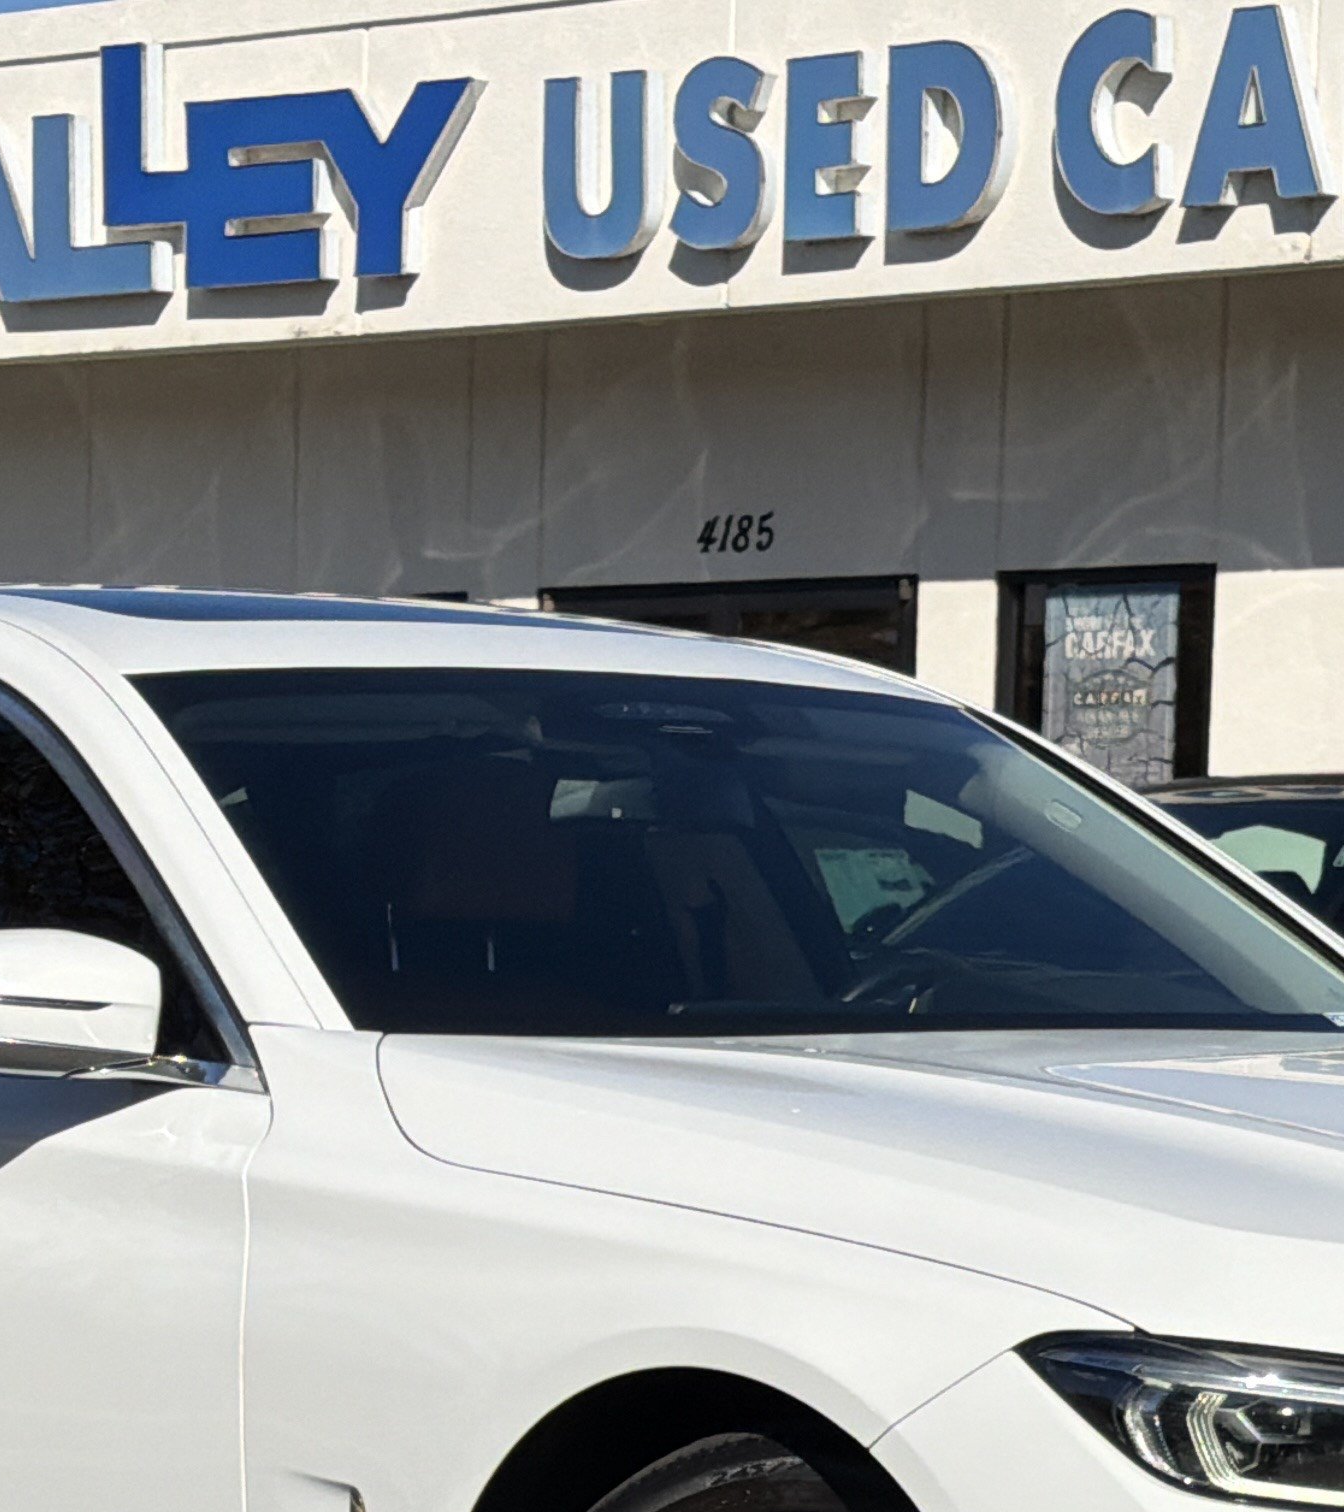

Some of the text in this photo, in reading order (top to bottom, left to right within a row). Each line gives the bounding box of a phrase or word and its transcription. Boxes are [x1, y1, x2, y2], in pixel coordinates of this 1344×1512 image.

[542, 40, 1006, 259] USED
[697, 510, 775, 553] 4185
[1064, 629, 1156, 659] CARFAX
